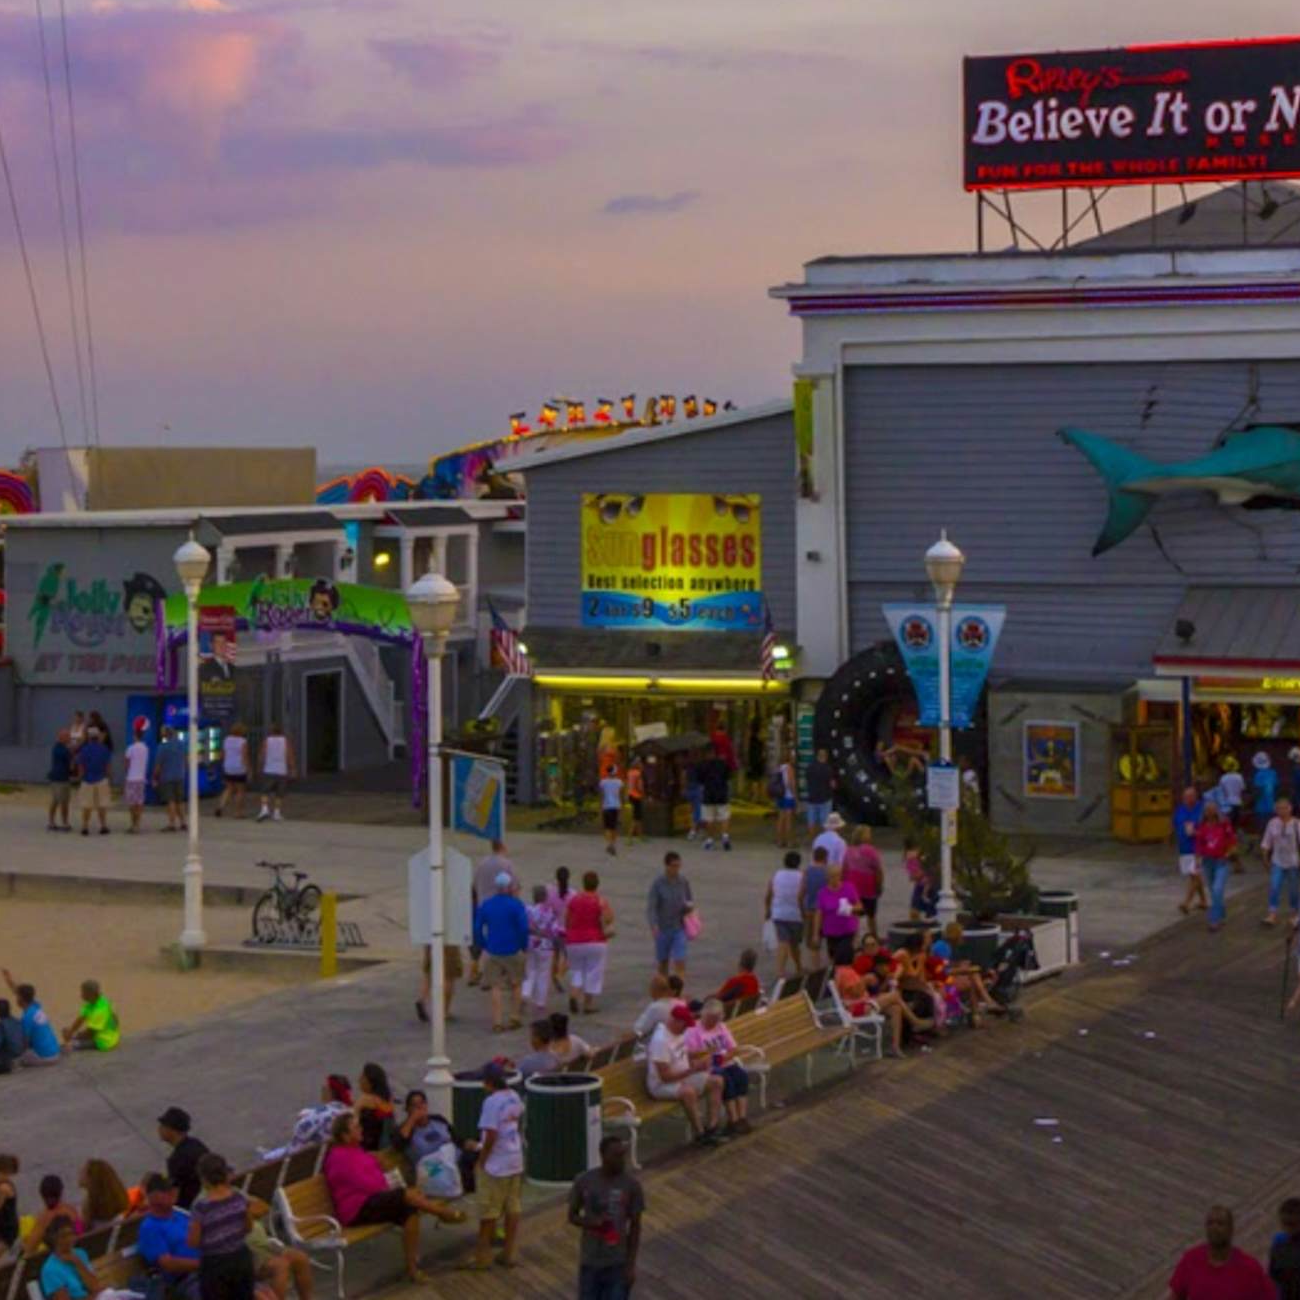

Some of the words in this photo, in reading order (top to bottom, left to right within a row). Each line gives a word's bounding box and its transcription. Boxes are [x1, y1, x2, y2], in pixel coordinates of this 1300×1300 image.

[971, 99, 1134, 145] Believe
[1146, 91, 1188, 136] It
[1204, 100, 1258, 134] or
[1067, 160, 1105, 175] THE
[621, 573, 685, 591] selection
[689, 574, 756, 593] anywhere
